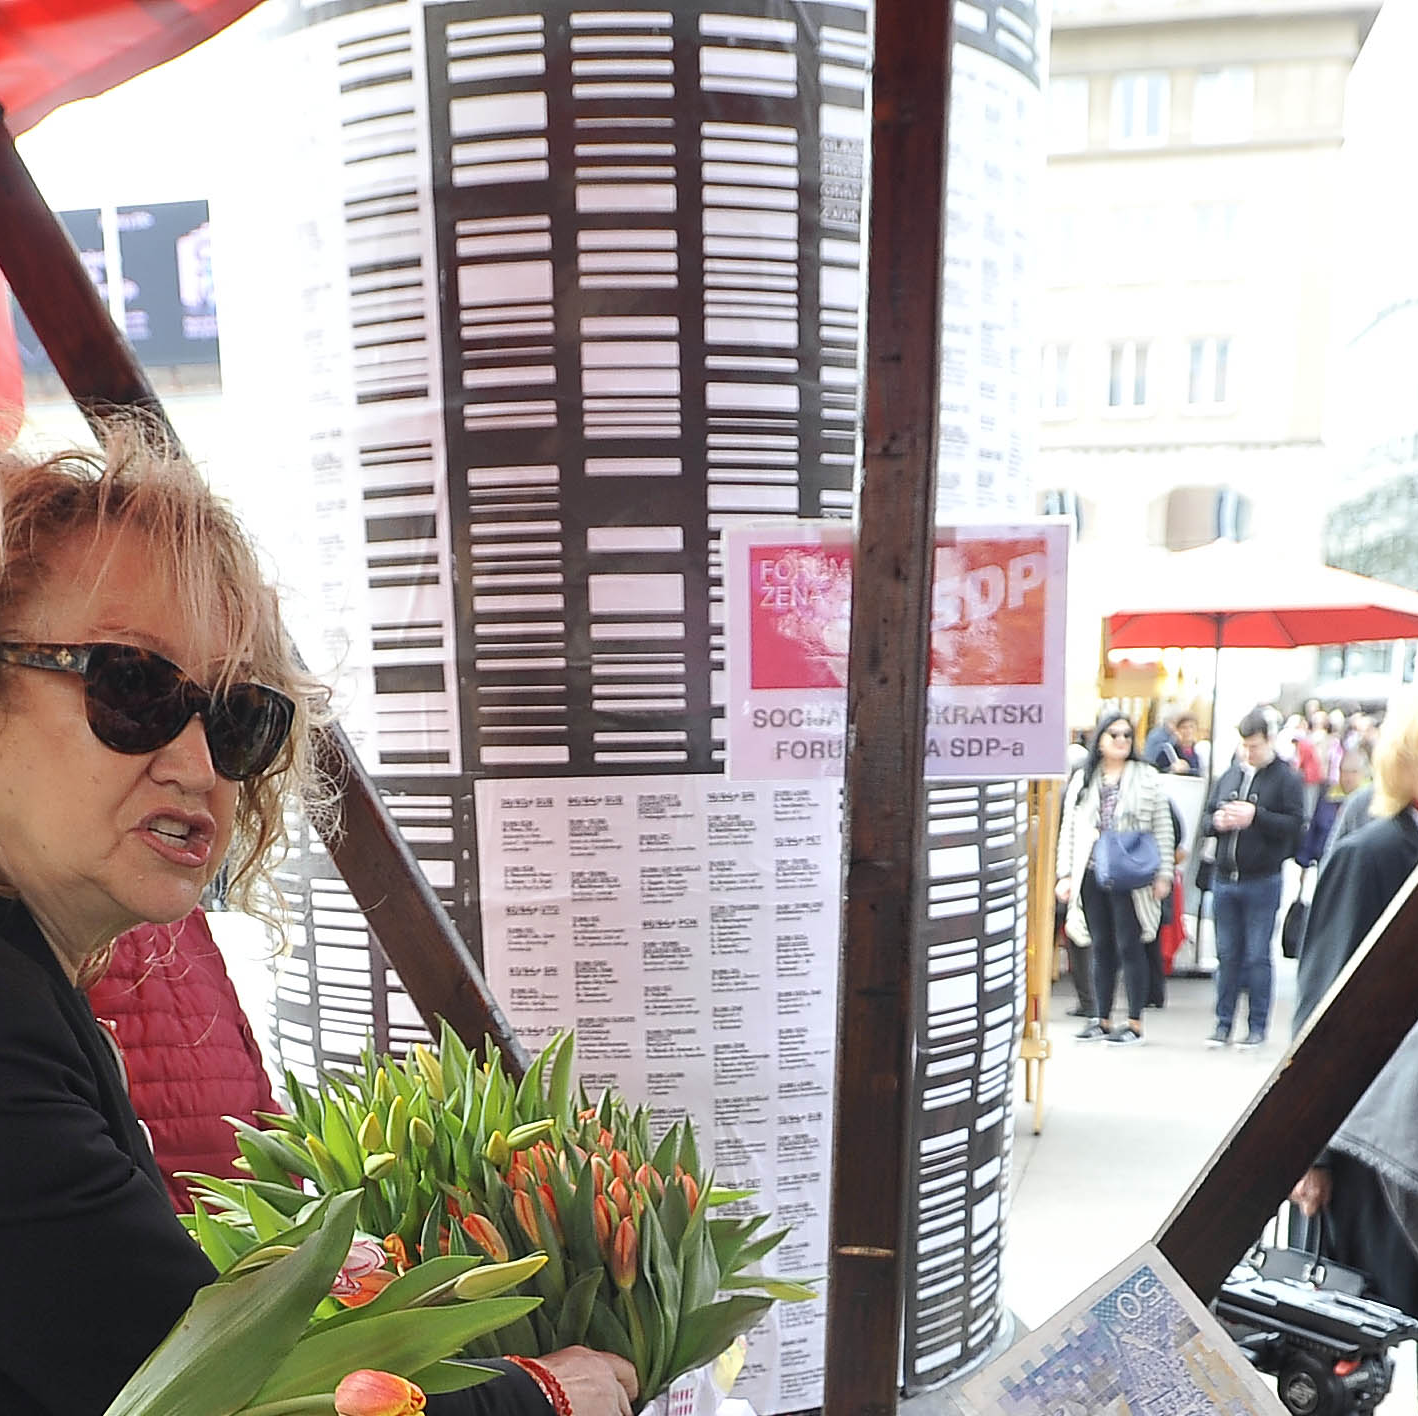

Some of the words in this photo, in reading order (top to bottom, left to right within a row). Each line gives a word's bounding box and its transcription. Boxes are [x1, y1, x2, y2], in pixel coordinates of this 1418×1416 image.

[929, 550, 1046, 631] SDP
[775, 739, 844, 760] FORU
[949, 737, 1025, 758] SDP-a
[1116, 1275, 1163, 1319] 50
